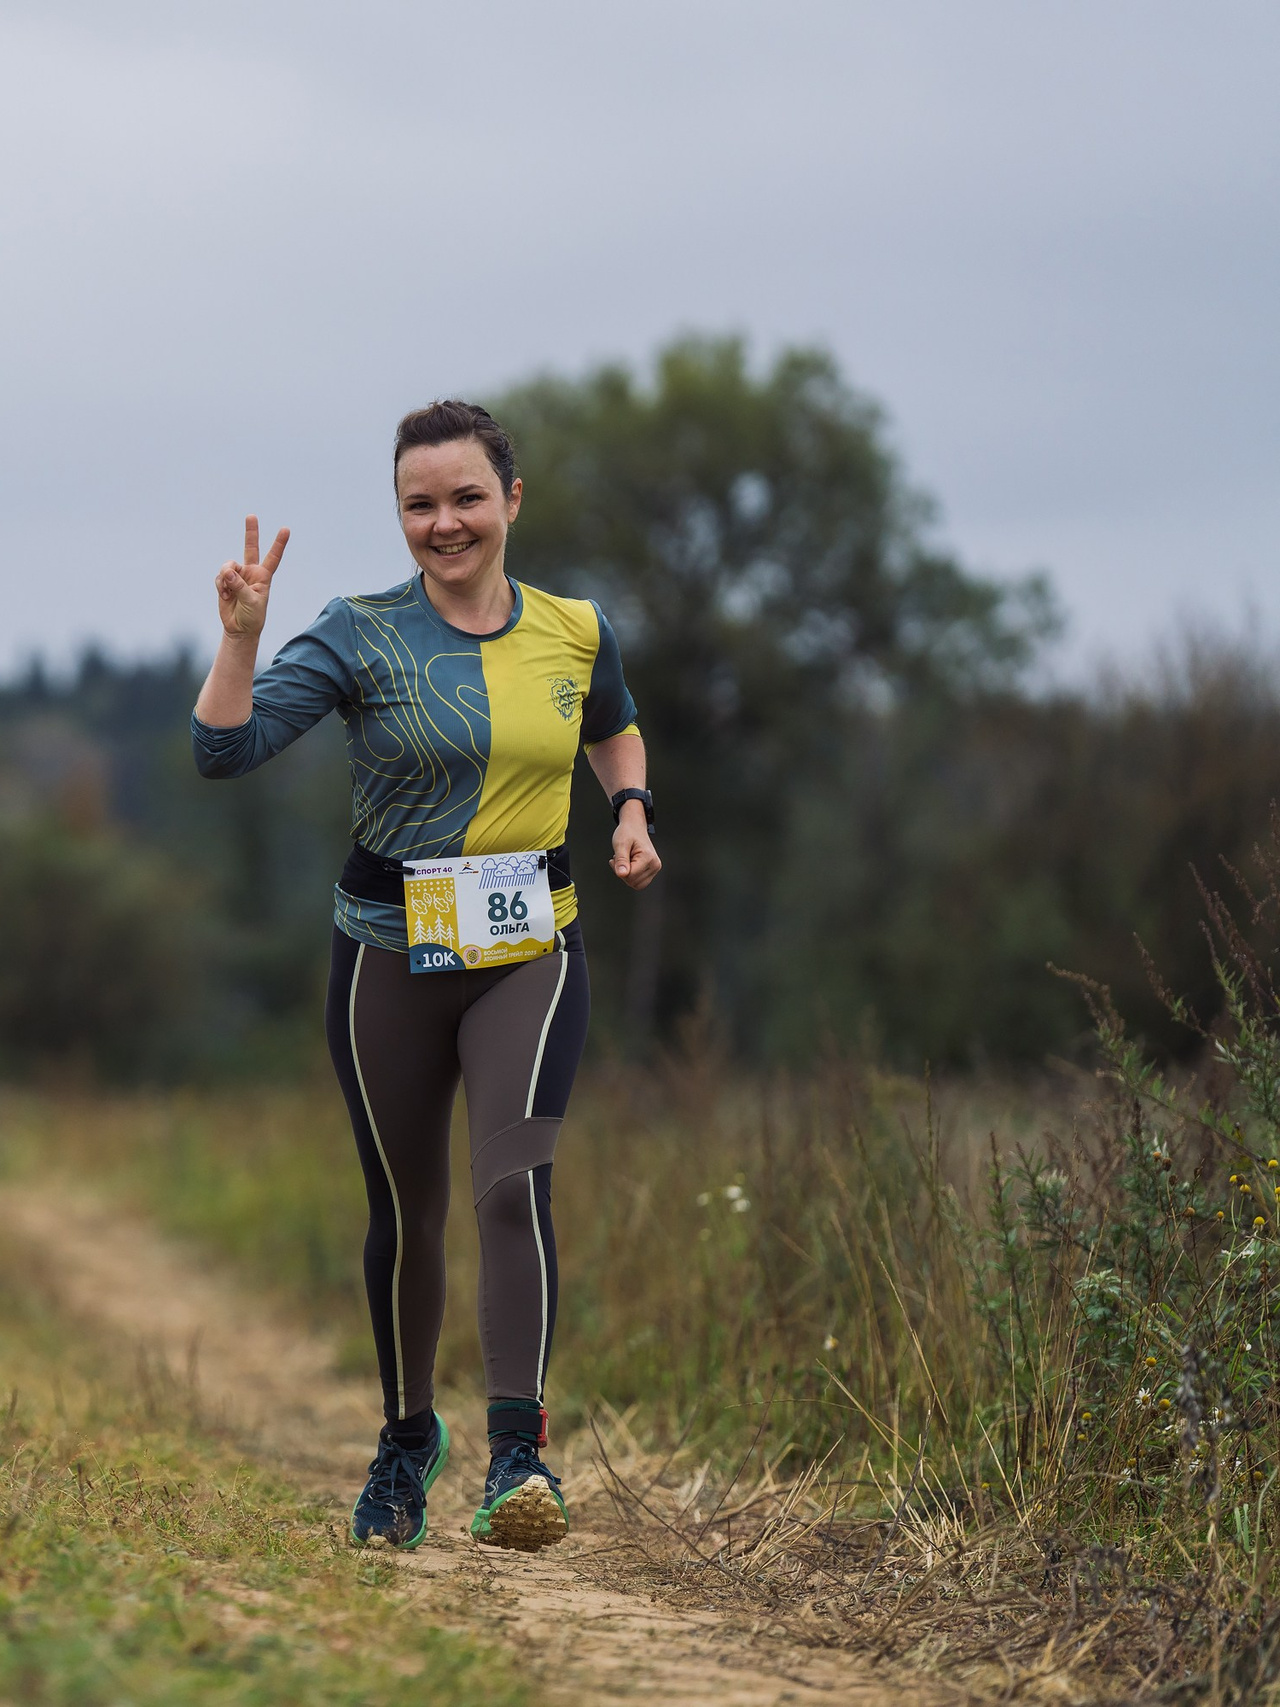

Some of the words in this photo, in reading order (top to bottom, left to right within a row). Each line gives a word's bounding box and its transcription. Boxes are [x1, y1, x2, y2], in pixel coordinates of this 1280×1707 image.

[416, 867, 441, 875] СПОРТ
[487, 891, 528, 922] 86
[490, 922, 530, 936] ОЛЬГА
